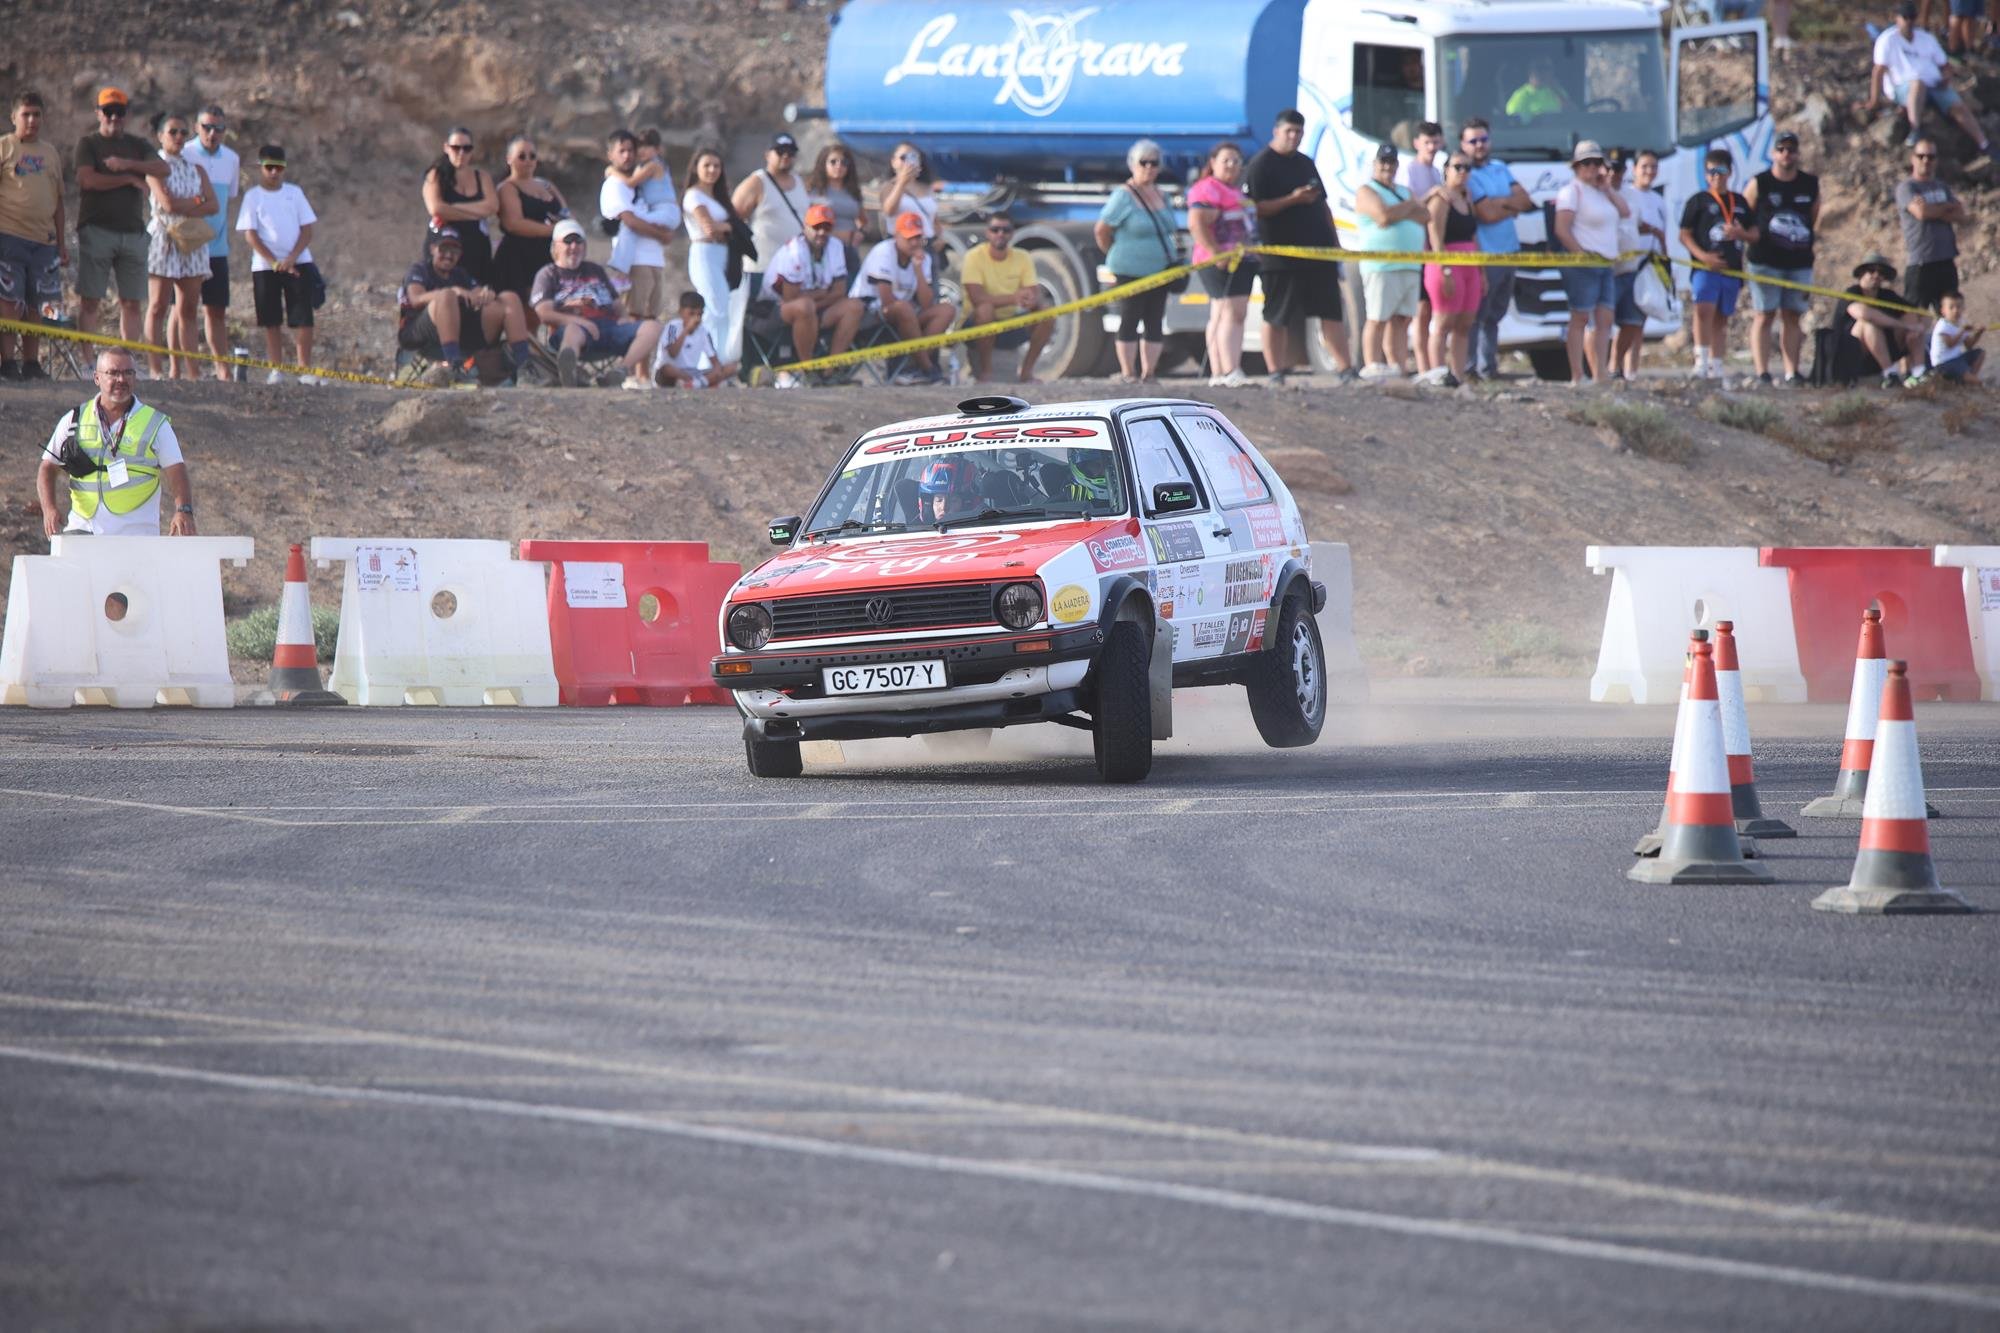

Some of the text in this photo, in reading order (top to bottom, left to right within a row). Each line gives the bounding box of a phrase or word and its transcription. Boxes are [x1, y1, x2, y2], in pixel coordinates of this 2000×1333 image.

[884, 13, 1188, 105] Lanzagrava
[864, 426, 1098, 455] CUCO
[1204, 620, 1225, 630] TALLER
[831, 664, 934, 691] GC 7507 Y
